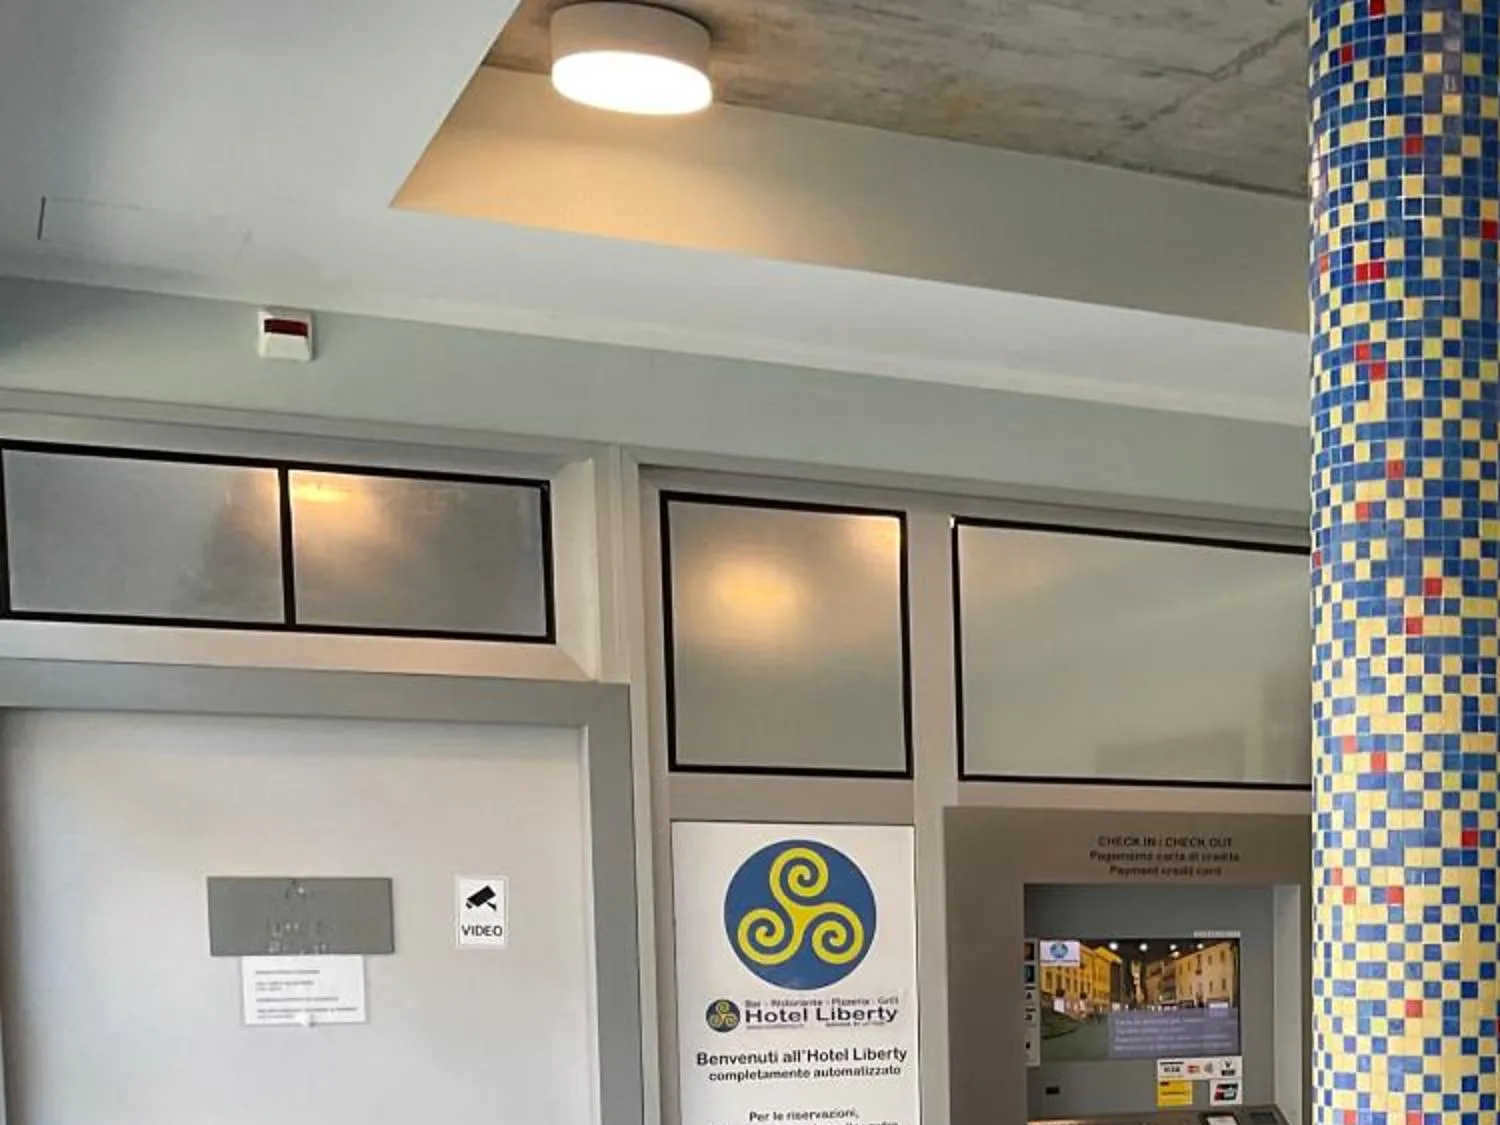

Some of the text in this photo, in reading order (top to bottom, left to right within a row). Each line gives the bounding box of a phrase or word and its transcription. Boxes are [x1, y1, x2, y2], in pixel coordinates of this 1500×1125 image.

[1098, 836, 1140, 847] CHECK
[1143, 836, 1157, 847] IN
[1165, 836, 1206, 848] CHECK
[1209, 837, 1233, 848] OUT
[461, 925, 503, 938] VIDEO
[744, 1005, 898, 1023] Hotel Liberty
[696, 1047, 908, 1067] Benvenuti all'Hotel Liberty
[708, 1066, 901, 1083] completamente automatizzato
[749, 1111, 770, 1121] Per
[772, 1110, 784, 1120] le
